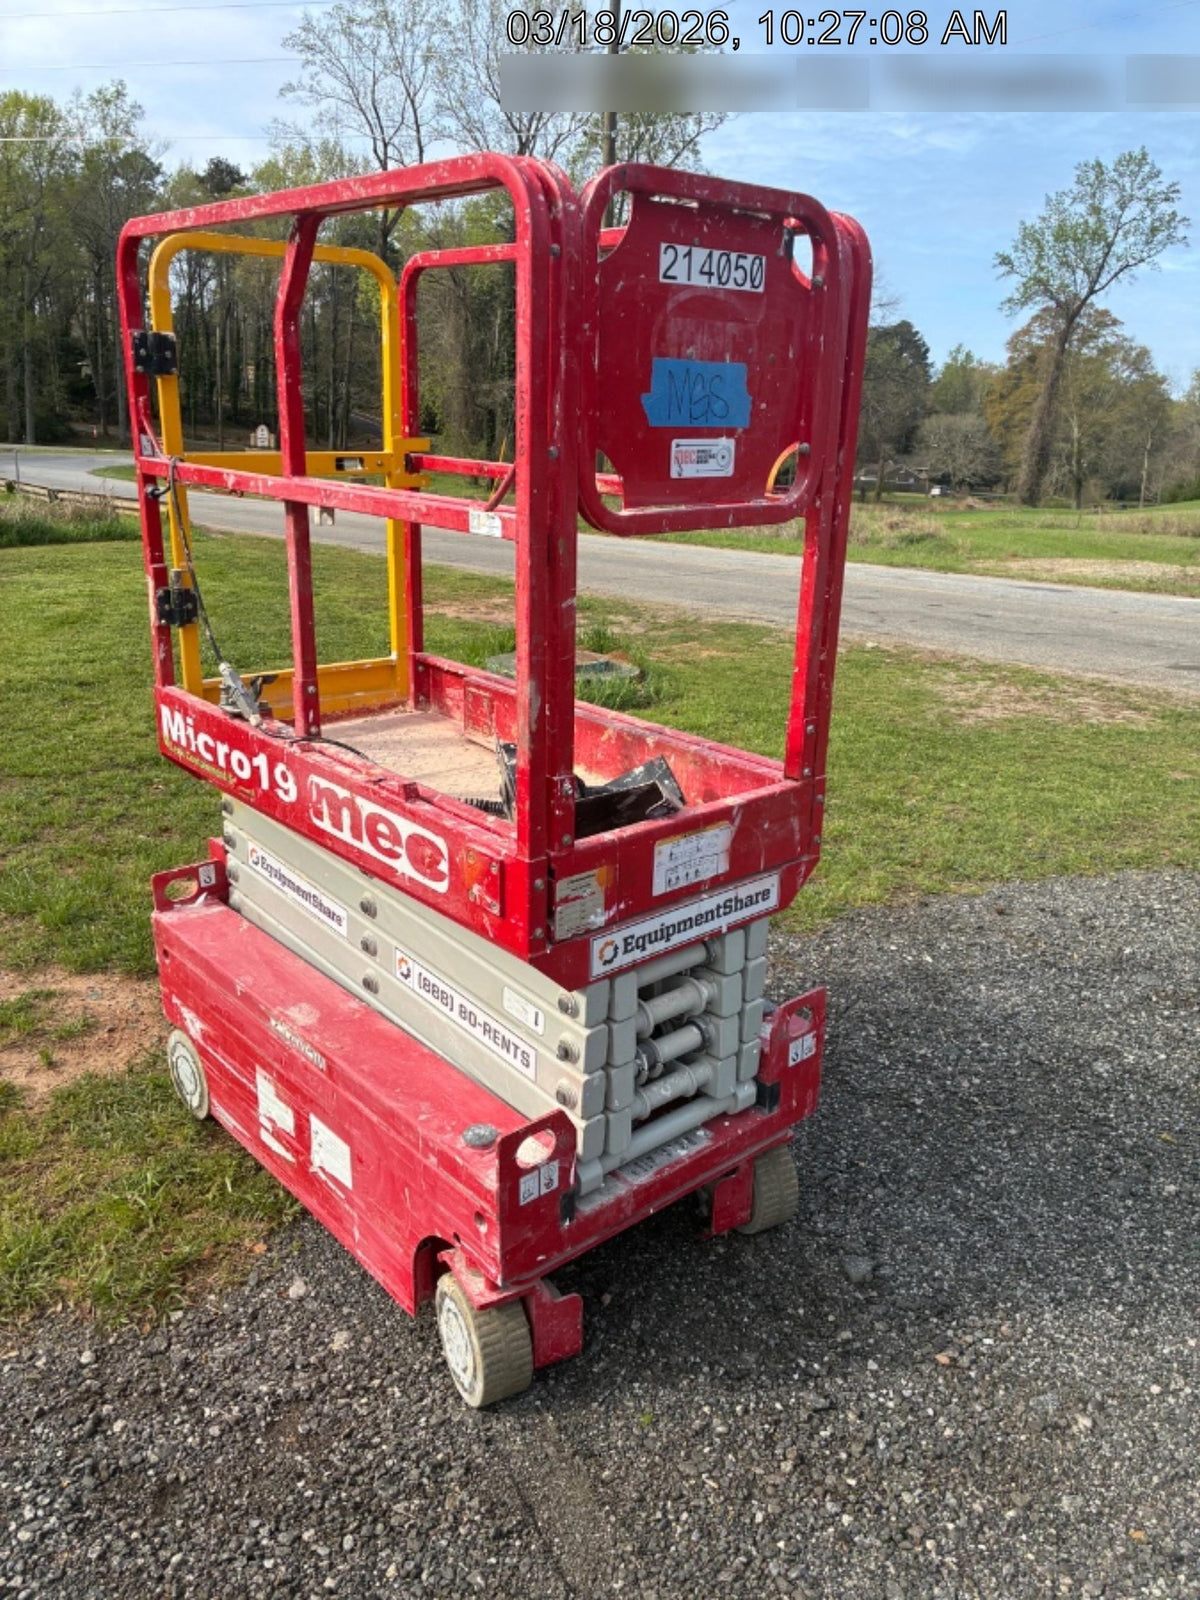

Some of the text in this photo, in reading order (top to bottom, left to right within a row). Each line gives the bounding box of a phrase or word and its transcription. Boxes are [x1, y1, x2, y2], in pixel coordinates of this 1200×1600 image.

[661, 244, 764, 289] 214050
[160, 703, 298, 803] Micro19
[260, 854, 343, 927] EquipmentShare
[622, 884, 771, 956] EquipmentShare
[417, 970, 531, 1069] (888) 80-RENTS
